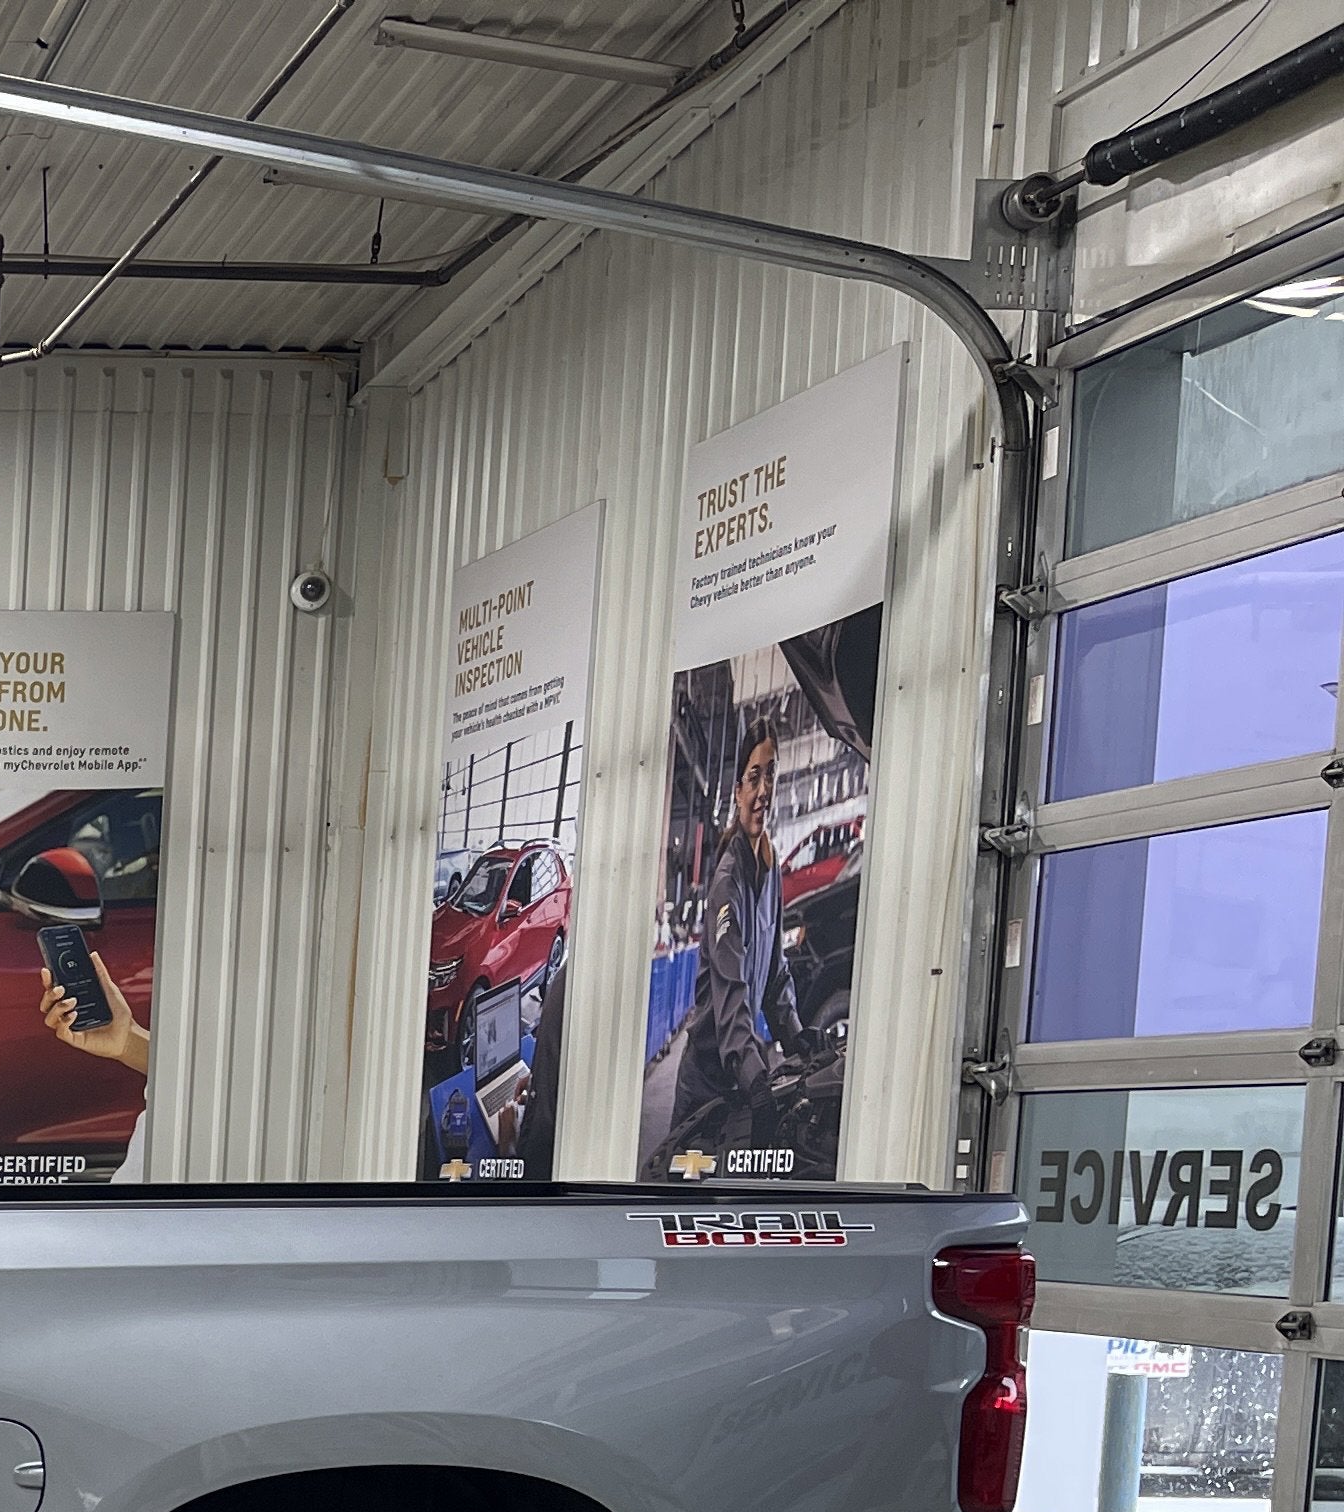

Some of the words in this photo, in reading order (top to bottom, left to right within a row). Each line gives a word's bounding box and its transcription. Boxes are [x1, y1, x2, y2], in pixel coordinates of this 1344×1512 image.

[697, 472, 749, 522] TRUST
[754, 455, 787, 497] THE
[694, 502, 773, 560] EXPERTS.
[692, 572, 719, 590] Factory
[720, 558, 747, 580] trained
[748, 542, 792, 569] technicians
[794, 534, 817, 551] know
[817, 524, 837, 546] your
[459, 580, 535, 635] MULTI-POINT
[690, 593, 712, 609] Chevy
[713, 582, 739, 602] vehicle
[740, 574, 764, 592] better
[766, 566, 783, 582] than
[457, 625, 505, 665] VEHICLE
[454, 650, 523, 698] INSPECTION
[4, 759, 75, 772] myChevrolet
[78, 760, 114, 770] Mobile
[32, 746, 53, 756] and
[56, 746, 86, 758] enjoy
[89, 746, 130, 756] remote
[479, 1159, 524, 1178] CERTIFIED
[727, 1149, 794, 1172] CERTIFIED
[626, 1211, 875, 1232] TRAIL
[663, 1231, 847, 1247] BOSS
